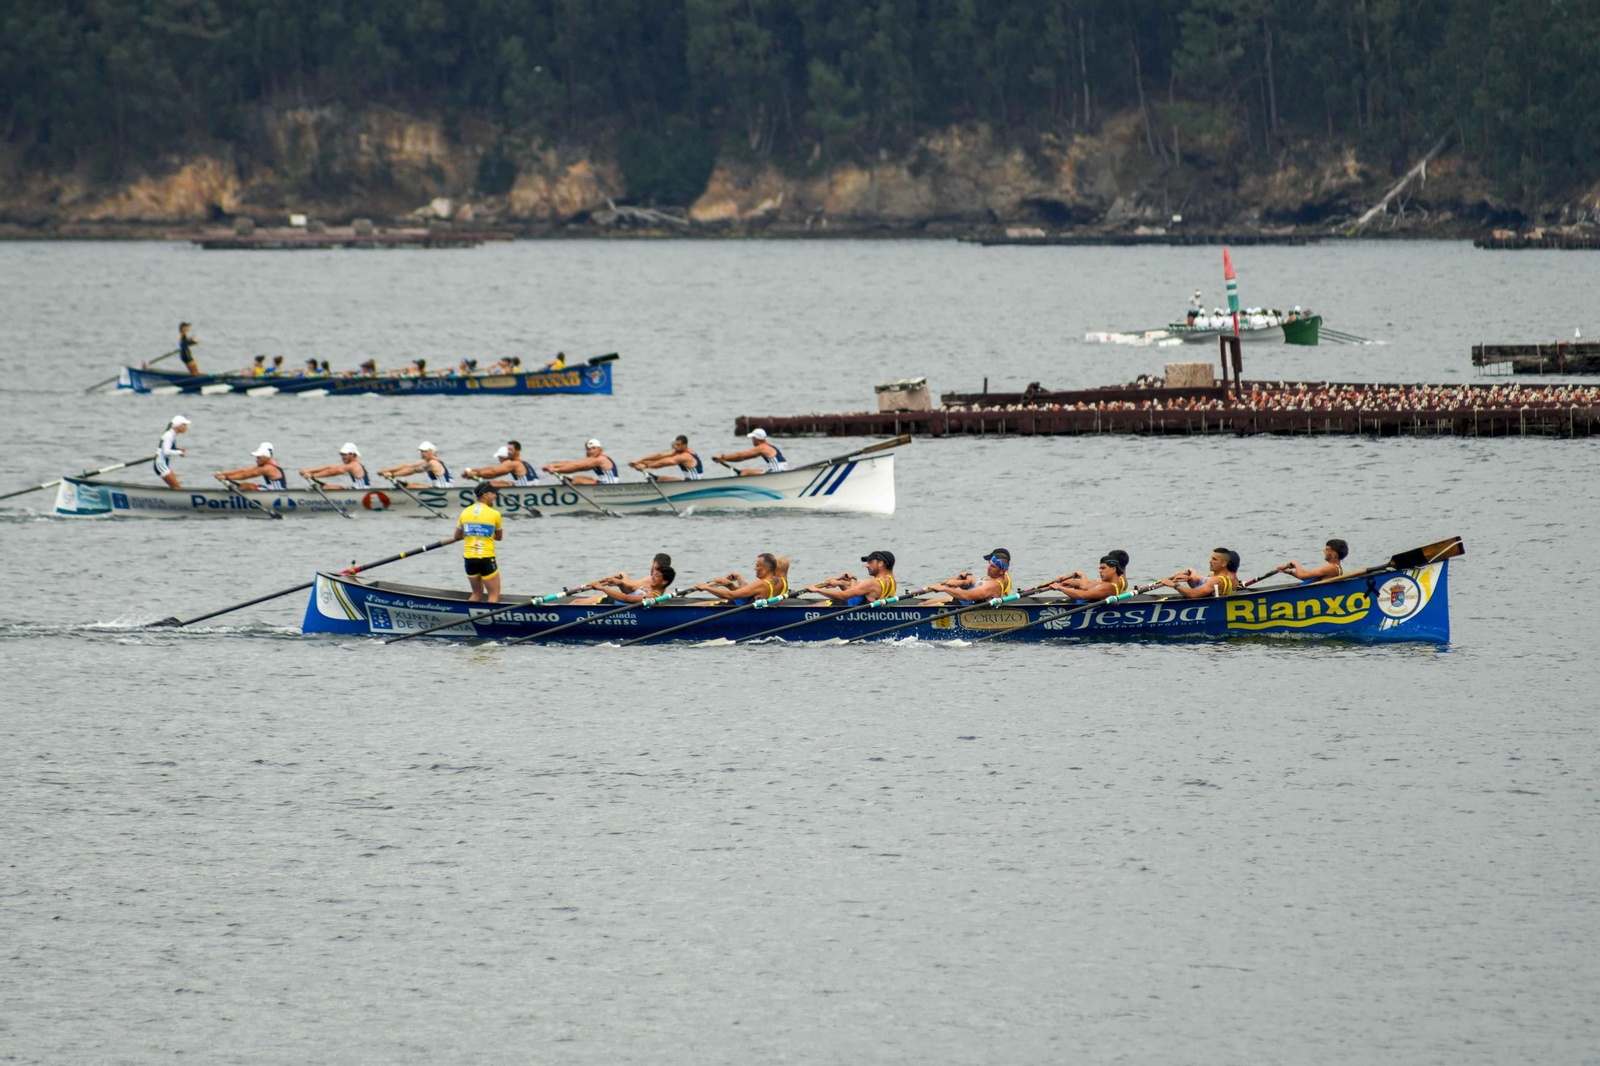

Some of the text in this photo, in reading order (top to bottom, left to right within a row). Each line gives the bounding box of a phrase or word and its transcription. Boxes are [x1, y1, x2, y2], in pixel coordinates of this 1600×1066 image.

[191, 495, 262, 510] Perillo
[459, 488, 578, 512] Slgado
[1226, 592, 1371, 622] Rianxo
[394, 610, 440, 623] XUNTA
[493, 609, 559, 622] Rianxo
[847, 611, 921, 621] JJCHICOLINO
[964, 613, 1023, 623] CORTIZO
[397, 621, 413, 629] DE
